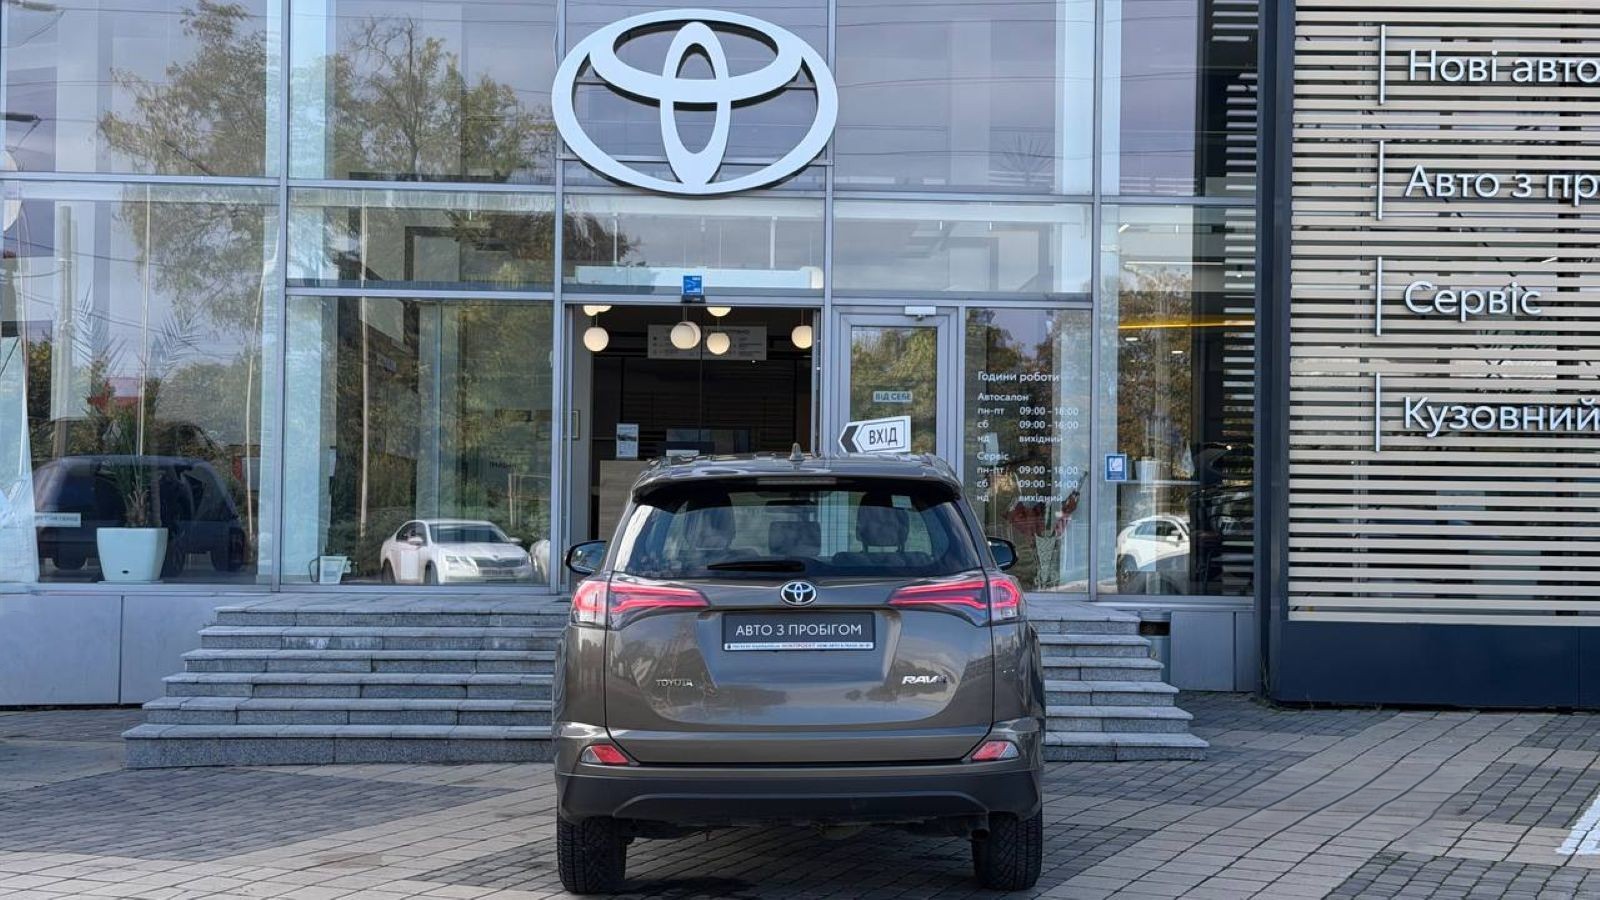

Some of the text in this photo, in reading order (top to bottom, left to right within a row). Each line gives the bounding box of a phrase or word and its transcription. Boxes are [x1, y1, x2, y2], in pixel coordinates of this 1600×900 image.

[1408, 49, 1600, 83] Нові авто
[1404, 164, 1500, 198] Авто
[1511, 173, 1532, 198] з
[1404, 280, 1542, 323] Сервіс
[977, 371, 1060, 383] Години роботи
[977, 392, 1029, 401] Автосалон
[977, 407, 1005, 415] пн-пт
[1019, 406, 1046, 416] 09:00
[1404, 396, 1600, 438] Кузовний
[977, 420, 989, 428] сб
[1019, 420, 1046, 429] 09:00
[869, 427, 898, 446] ВХІД
[977, 434, 1062, 443] нд вихідний
[976, 452, 1009, 462] Сервіс
[976, 466, 1004, 474] пн-пт
[1019, 465, 1046, 475] 09:00
[976, 479, 989, 488] сб
[1019, 479, 1046, 488] 09:00
[1019, 494, 1062, 502] вихідний
[735, 624, 862, 636] АВТО З ПРОБІГОМ
